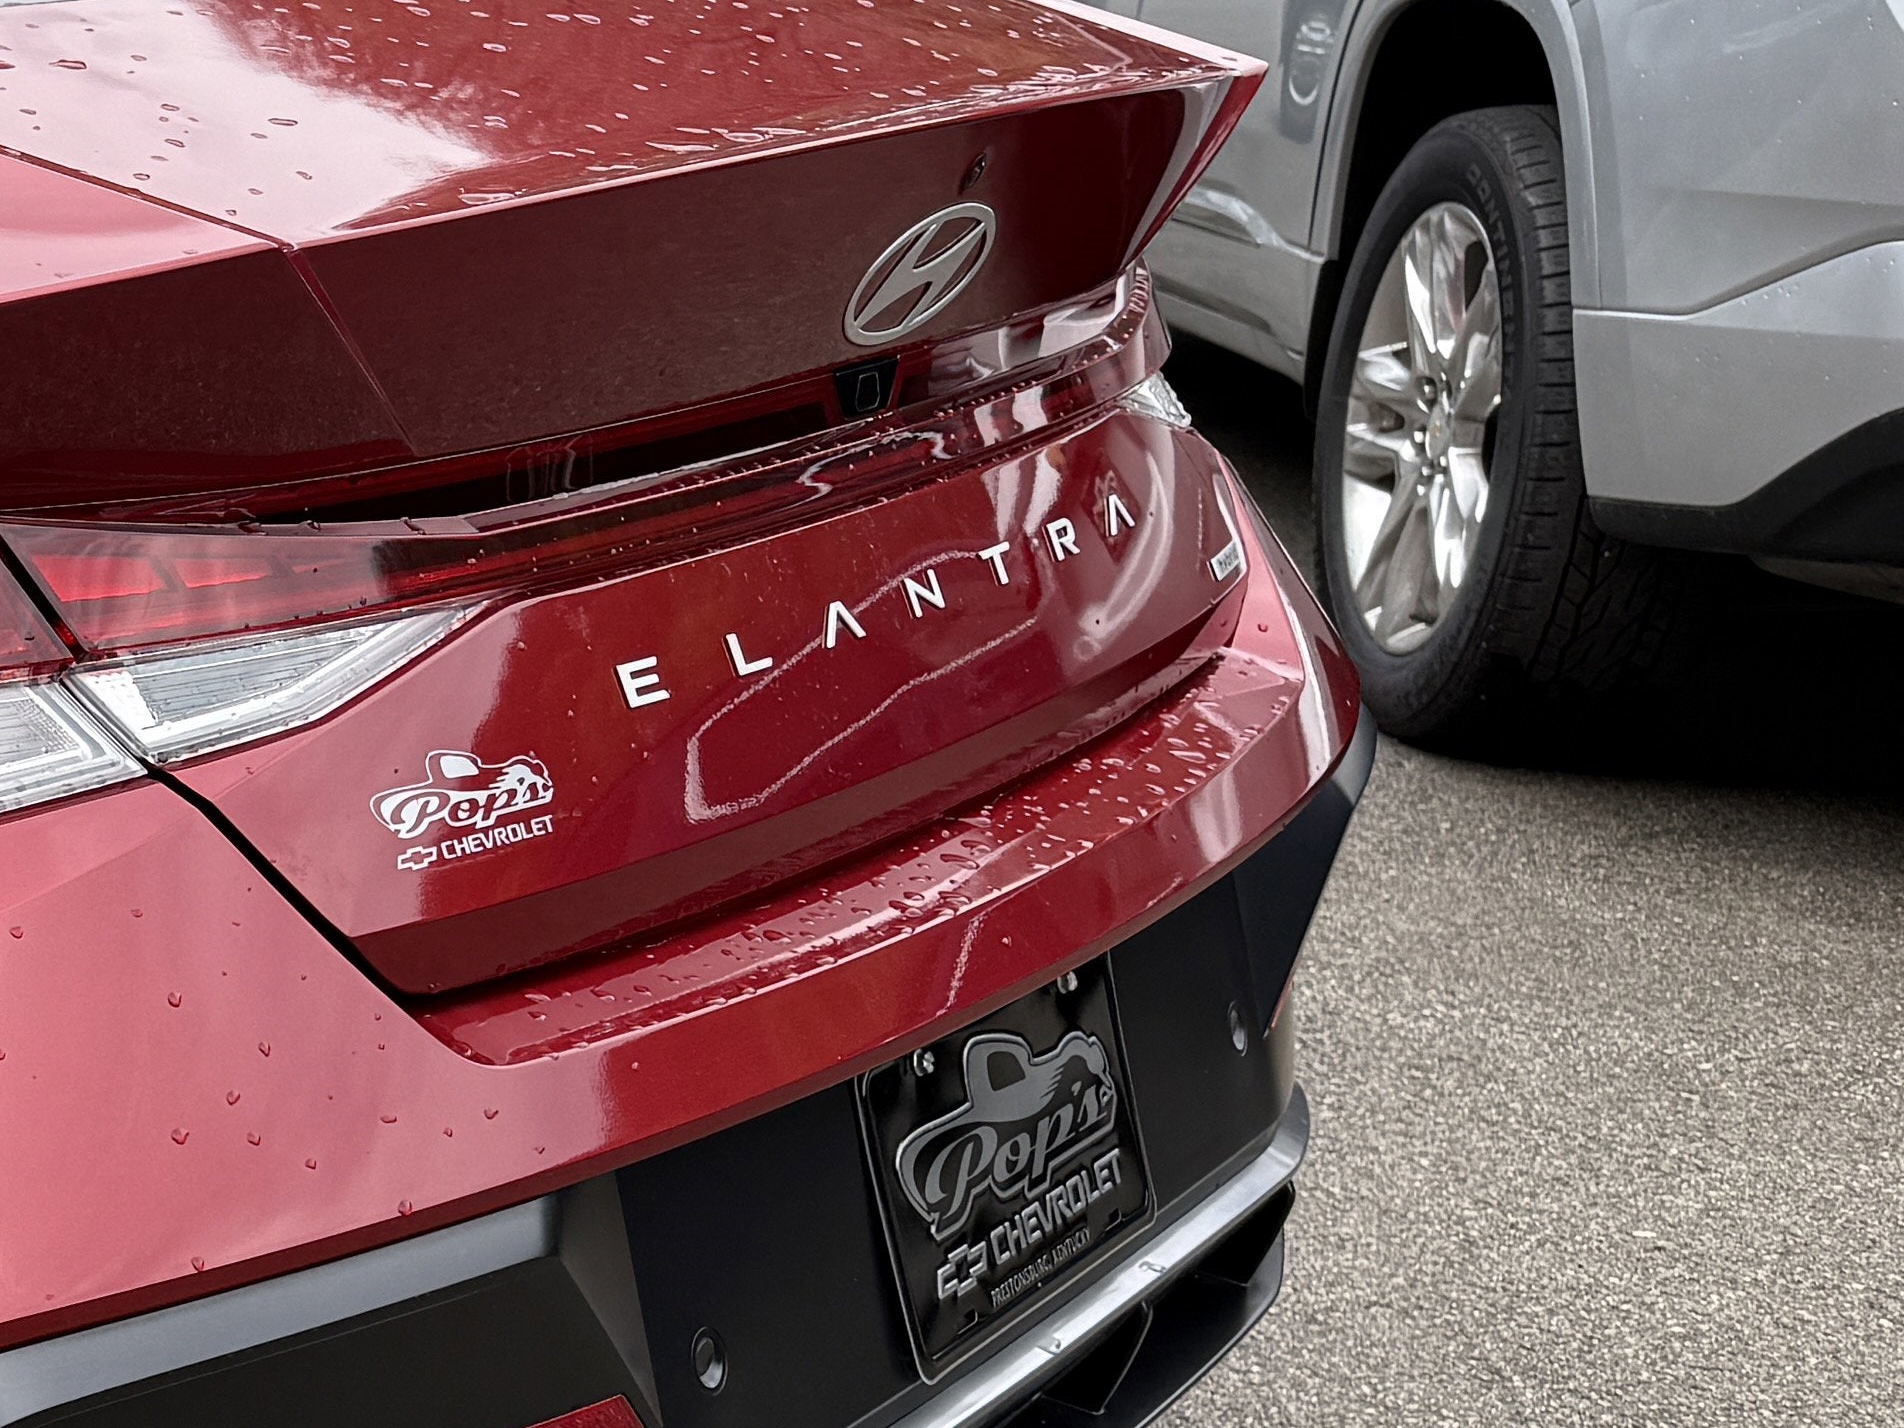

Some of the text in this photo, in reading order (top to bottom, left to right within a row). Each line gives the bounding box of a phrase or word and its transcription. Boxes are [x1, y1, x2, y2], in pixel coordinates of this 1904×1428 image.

[615, 492, 1137, 710] ELANTRA
[388, 775, 552, 836] Pop's
[440, 814, 554, 860] CHEVROLET
[923, 1076, 1118, 1224] Pop's
[989, 1147, 1122, 1264] CHEVROLET
